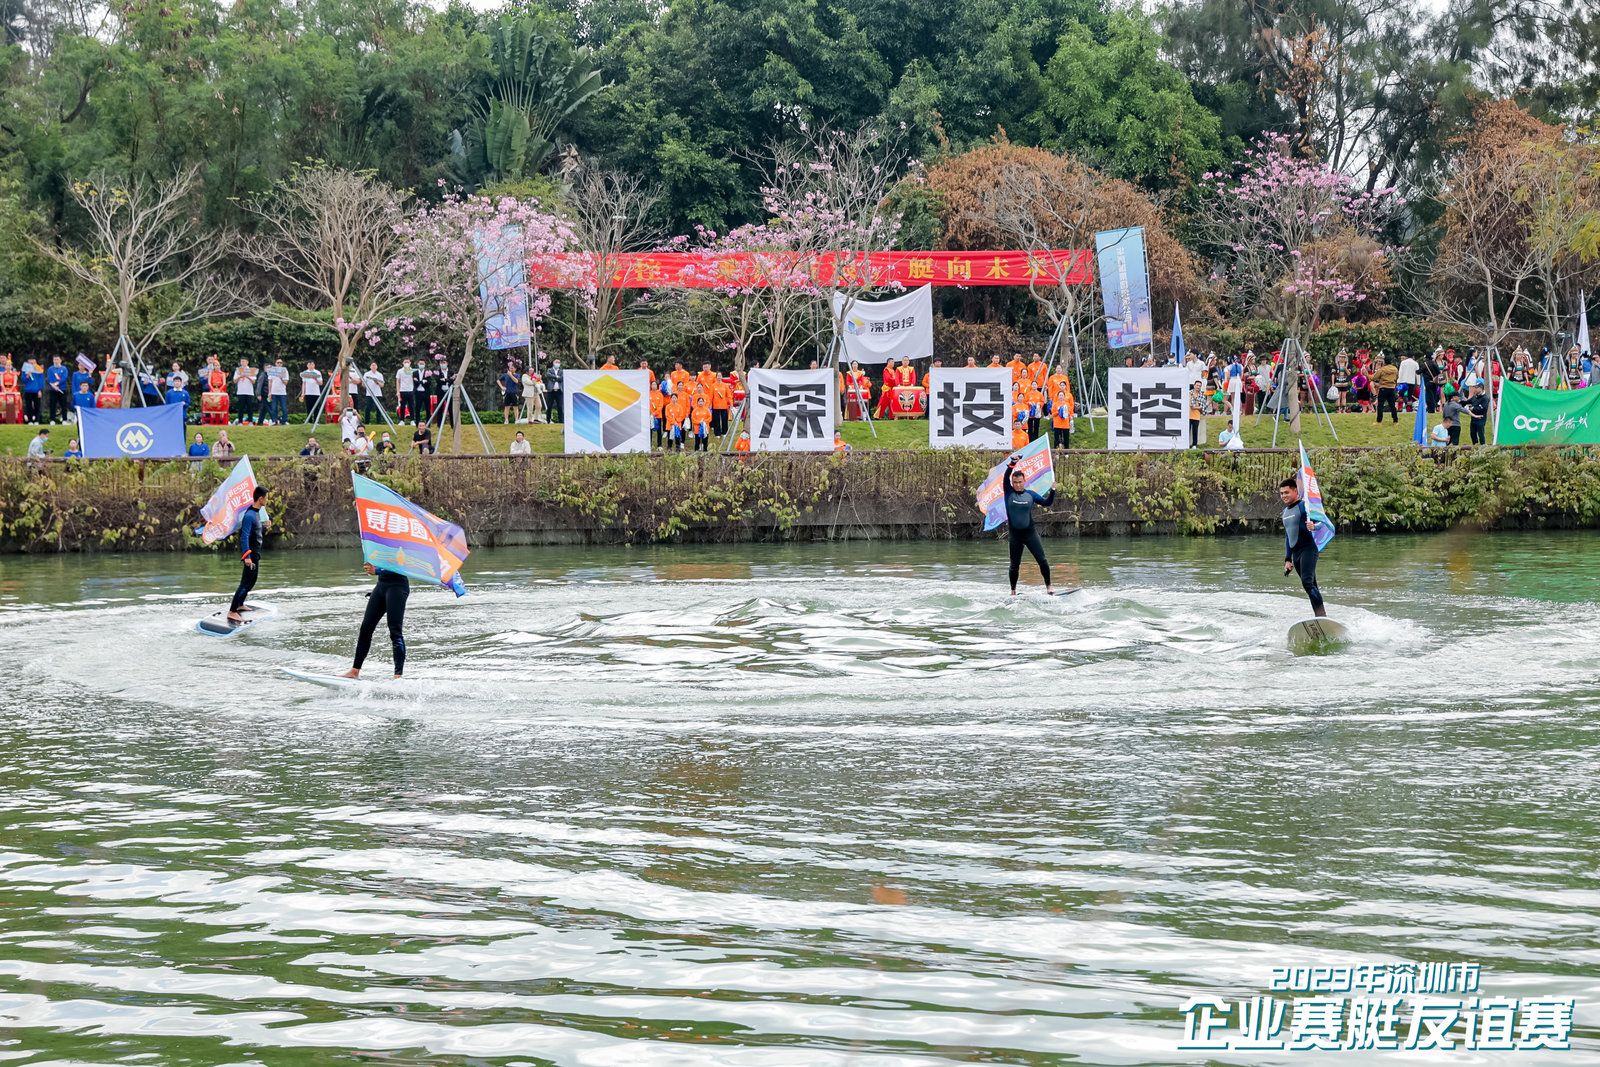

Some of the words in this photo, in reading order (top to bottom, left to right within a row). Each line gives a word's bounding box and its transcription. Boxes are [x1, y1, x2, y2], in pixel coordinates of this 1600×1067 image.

[869, 316, 915, 332] 深投控
[758, 383, 826, 438] 深
[937, 382, 1004, 436] 投
[1116, 382, 1181, 436] 控
[1513, 414, 1552, 432] OCT
